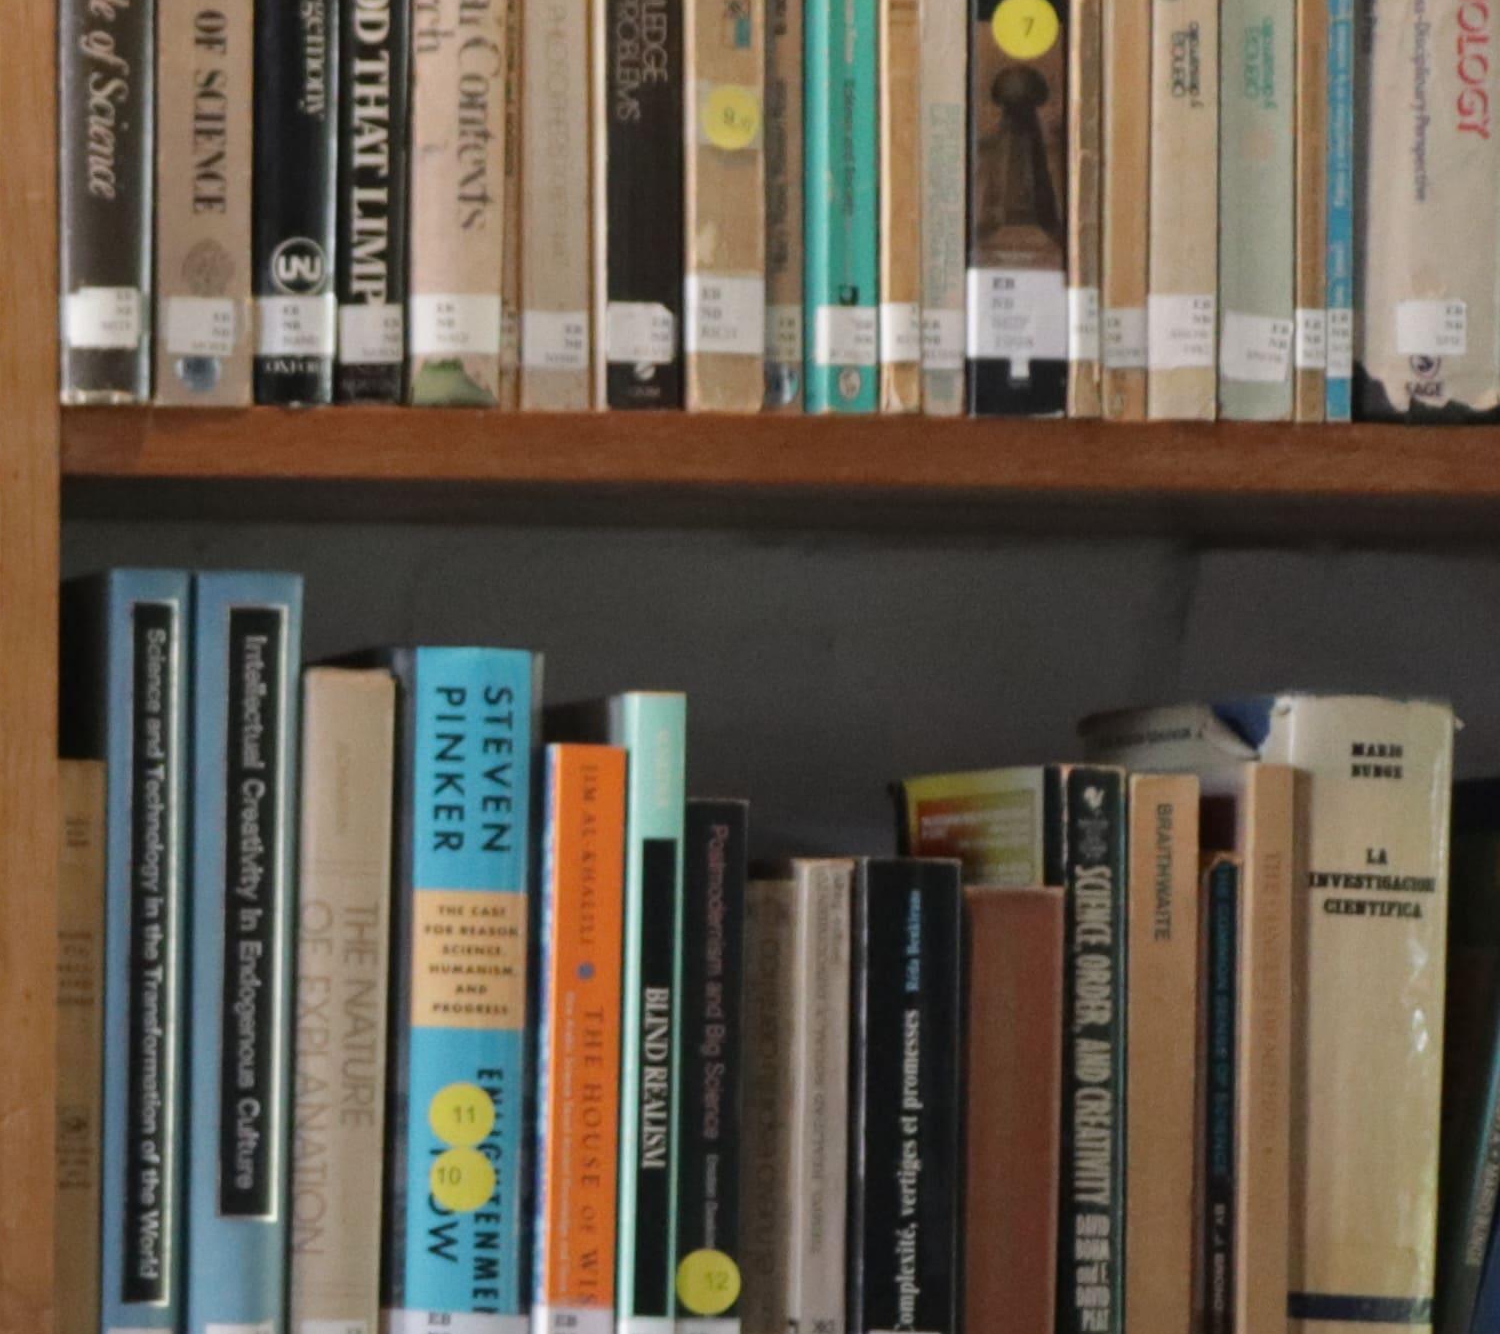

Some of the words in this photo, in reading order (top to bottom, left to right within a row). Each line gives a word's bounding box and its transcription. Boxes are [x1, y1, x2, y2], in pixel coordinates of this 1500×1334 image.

[79, 30, 128, 68] of
[193, 10, 226, 57] OF
[86, 73, 125, 199] Science
[191, 69, 228, 216] SCIENCE
[353, 49, 389, 177] THAT
[433, 685, 465, 853] PINKER
[482, 685, 514, 855] STEVEN
[1074, 866, 1111, 951] SCIENCE,
[644, 986, 671, 1060] BLIND
[1074, 953, 1110, 1032] ORDER,
[1074, 1037, 1109, 1082] AND
[641, 1064, 669, 1168] REALISM
[1074, 1086, 1110, 1205] CREATIVITY
